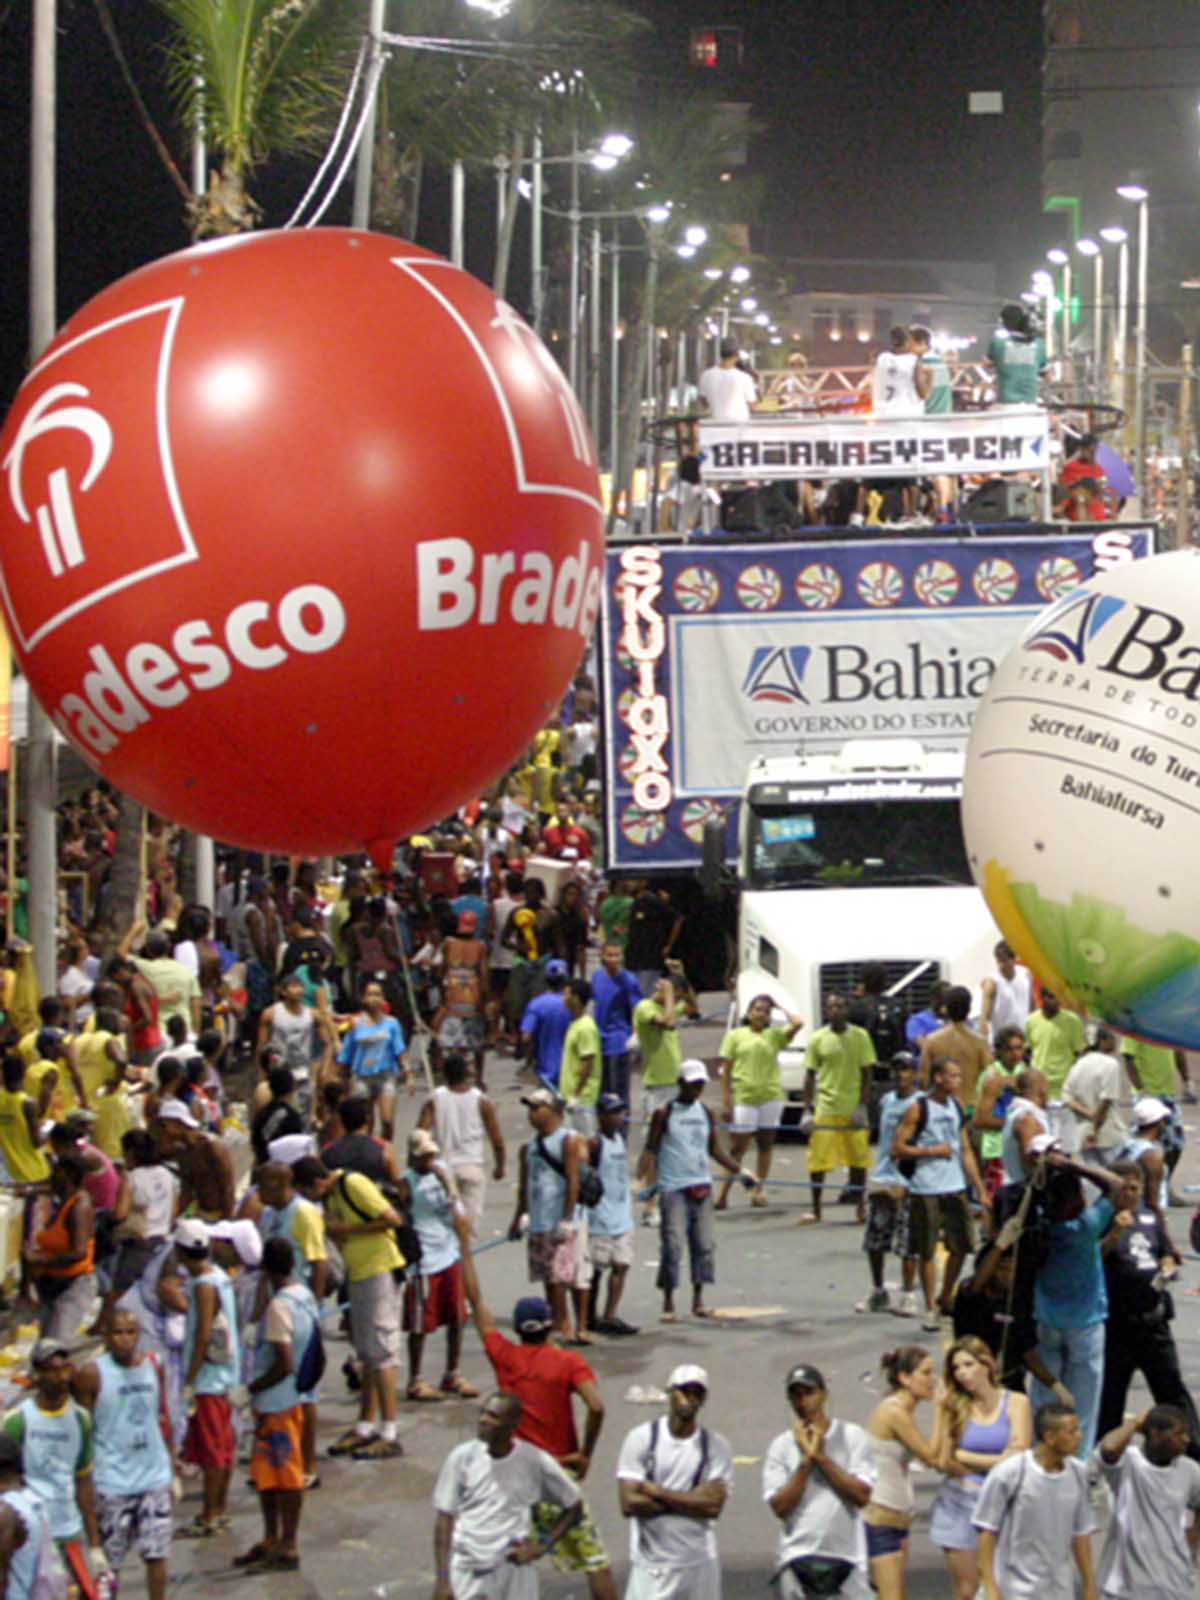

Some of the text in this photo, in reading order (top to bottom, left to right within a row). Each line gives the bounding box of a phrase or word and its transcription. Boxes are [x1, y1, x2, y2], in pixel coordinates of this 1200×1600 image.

[821, 643, 997, 704] Bahia
[1017, 666, 1091, 692] TERRA
[1104, 684, 1136, 705] DE
[755, 714, 866, 734] GOVERNO
[873, 714, 905, 731] DO
[1028, 713, 1121, 753] Secretaria
[1130, 744, 1158, 767] do
[1060, 773, 1166, 830] Bahiatursa
